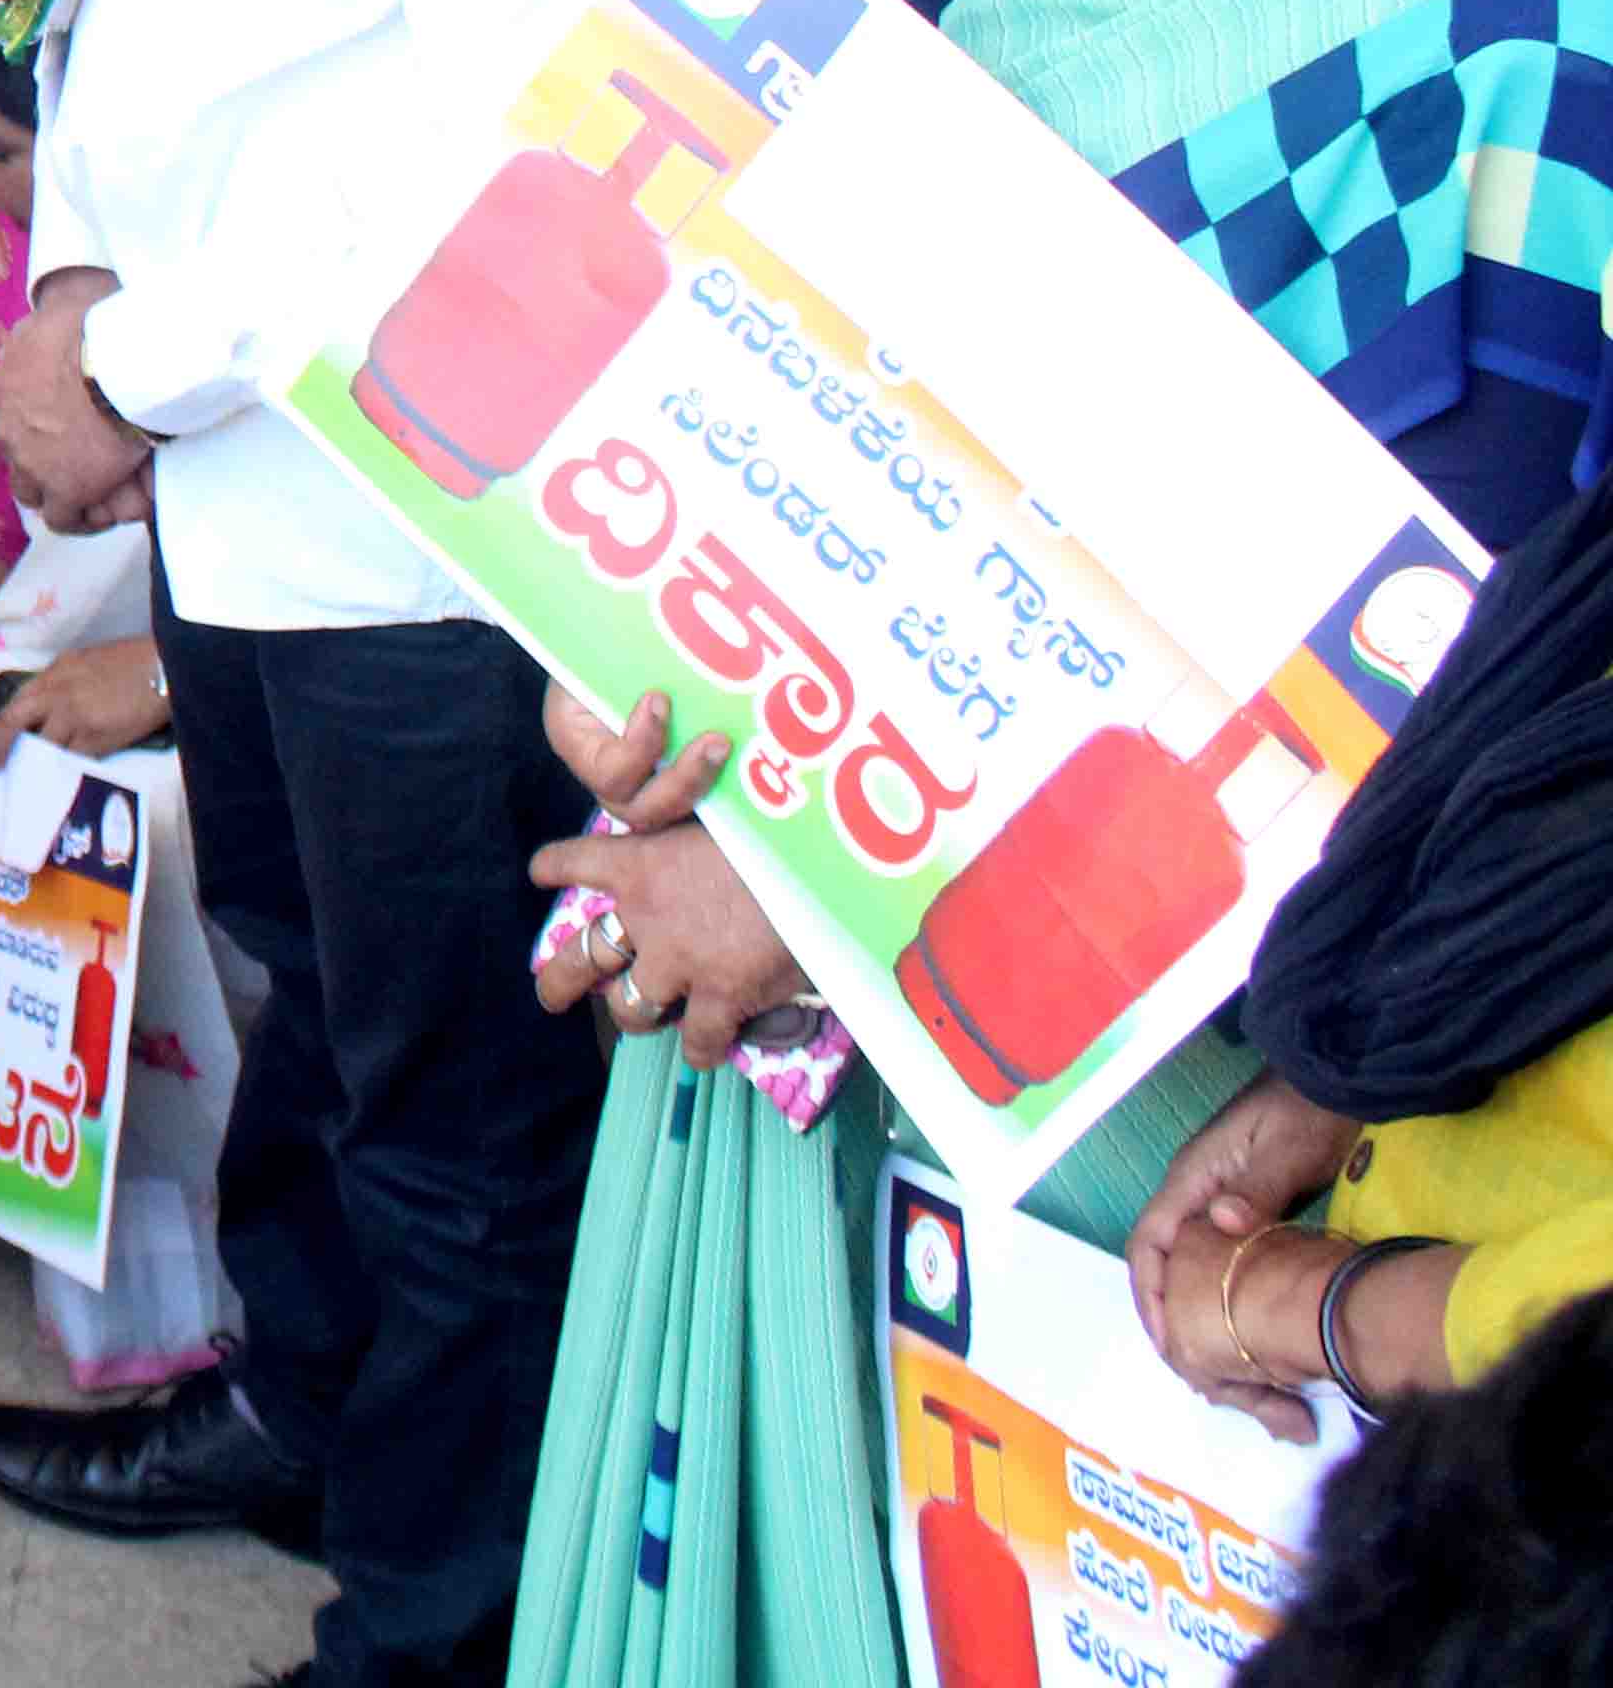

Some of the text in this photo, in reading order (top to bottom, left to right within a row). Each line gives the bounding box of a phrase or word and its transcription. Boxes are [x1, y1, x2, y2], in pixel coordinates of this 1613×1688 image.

[691, 269, 1125, 688] ದಿನಬಳಕೆಯ ಗ್ಯಾಸ್
[542, 438, 978, 865] ದಿಕ್ಕಾರ
[889, 606, 1017, 741] ಬೆಲೆಗೆ
[1072, 1460, 1203, 1585] ಸಾಮಾನ್ಯ
